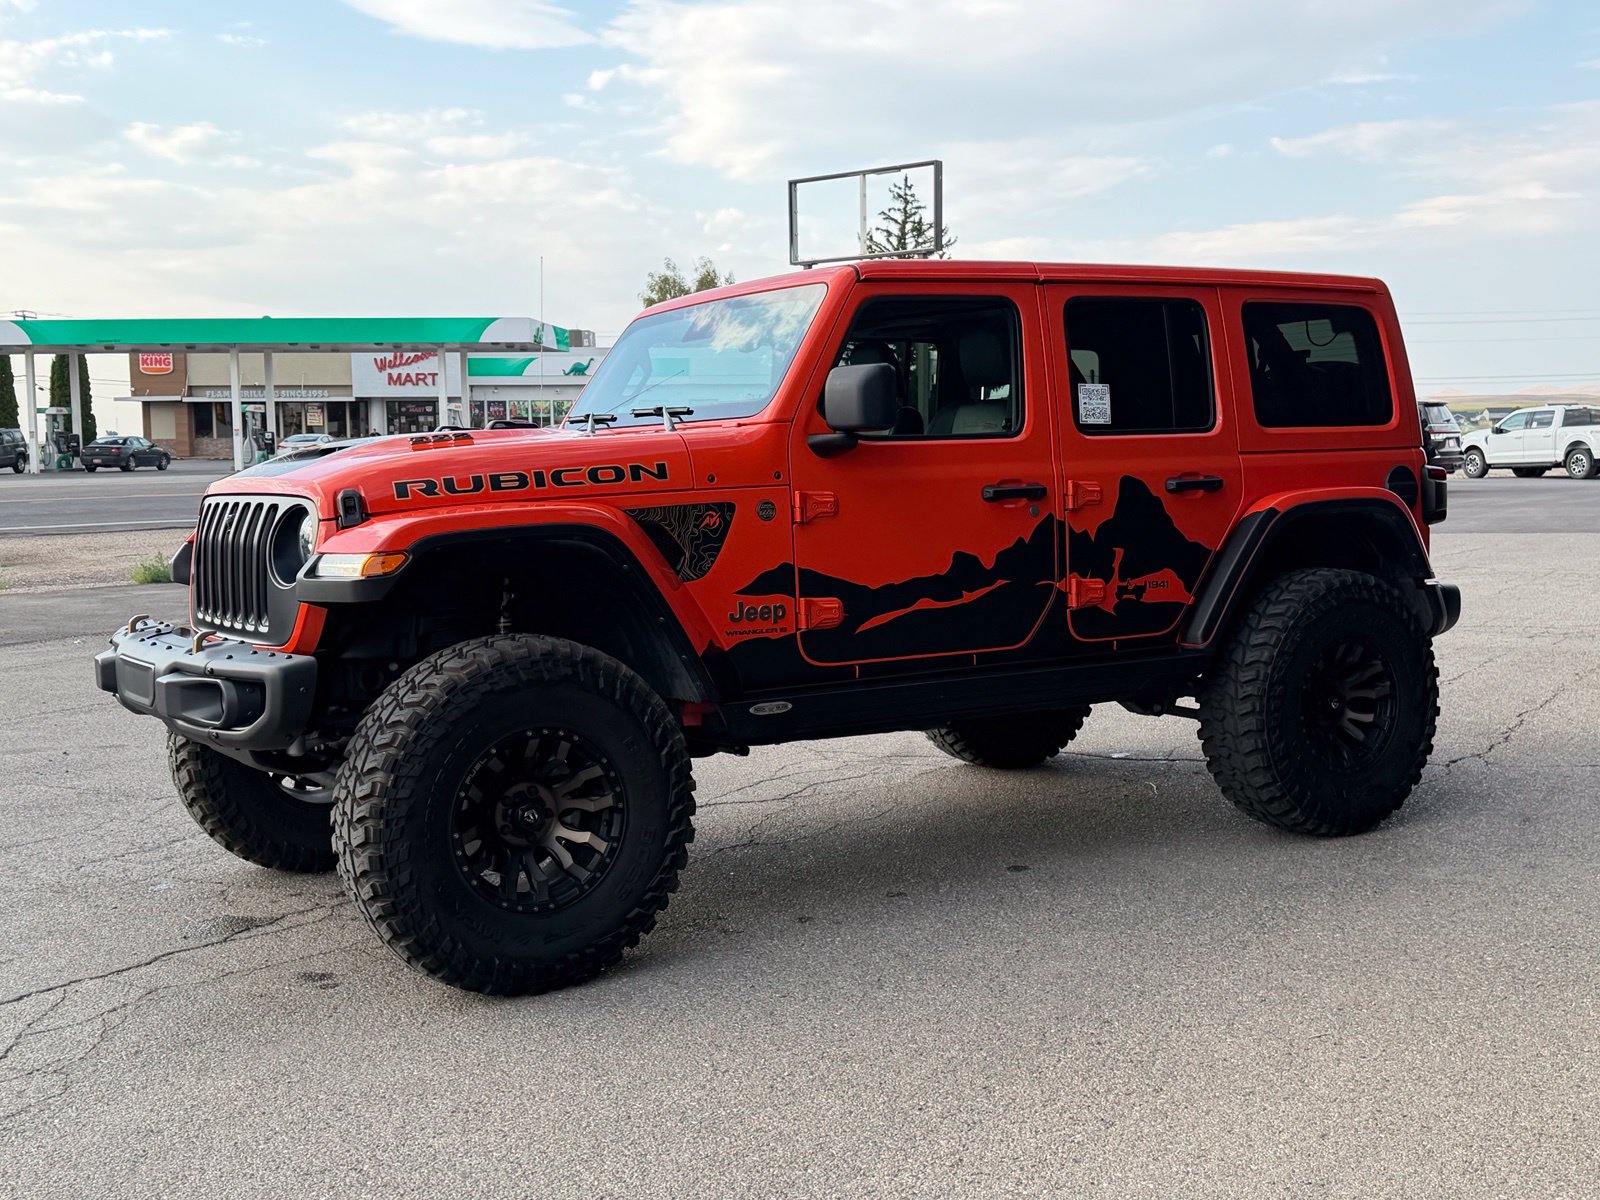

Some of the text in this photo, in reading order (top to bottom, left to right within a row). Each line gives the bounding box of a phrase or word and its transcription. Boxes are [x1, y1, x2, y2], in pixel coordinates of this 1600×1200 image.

[141, 356, 172, 367] KING
[388, 373, 438, 386] MART
[206, 390, 232, 398] FLAM
[392, 461, 669, 500] RUBICON
[1148, 580, 1169, 588] 1941
[728, 601, 786, 624] Jeep
[725, 627, 778, 636] WRANGLER
